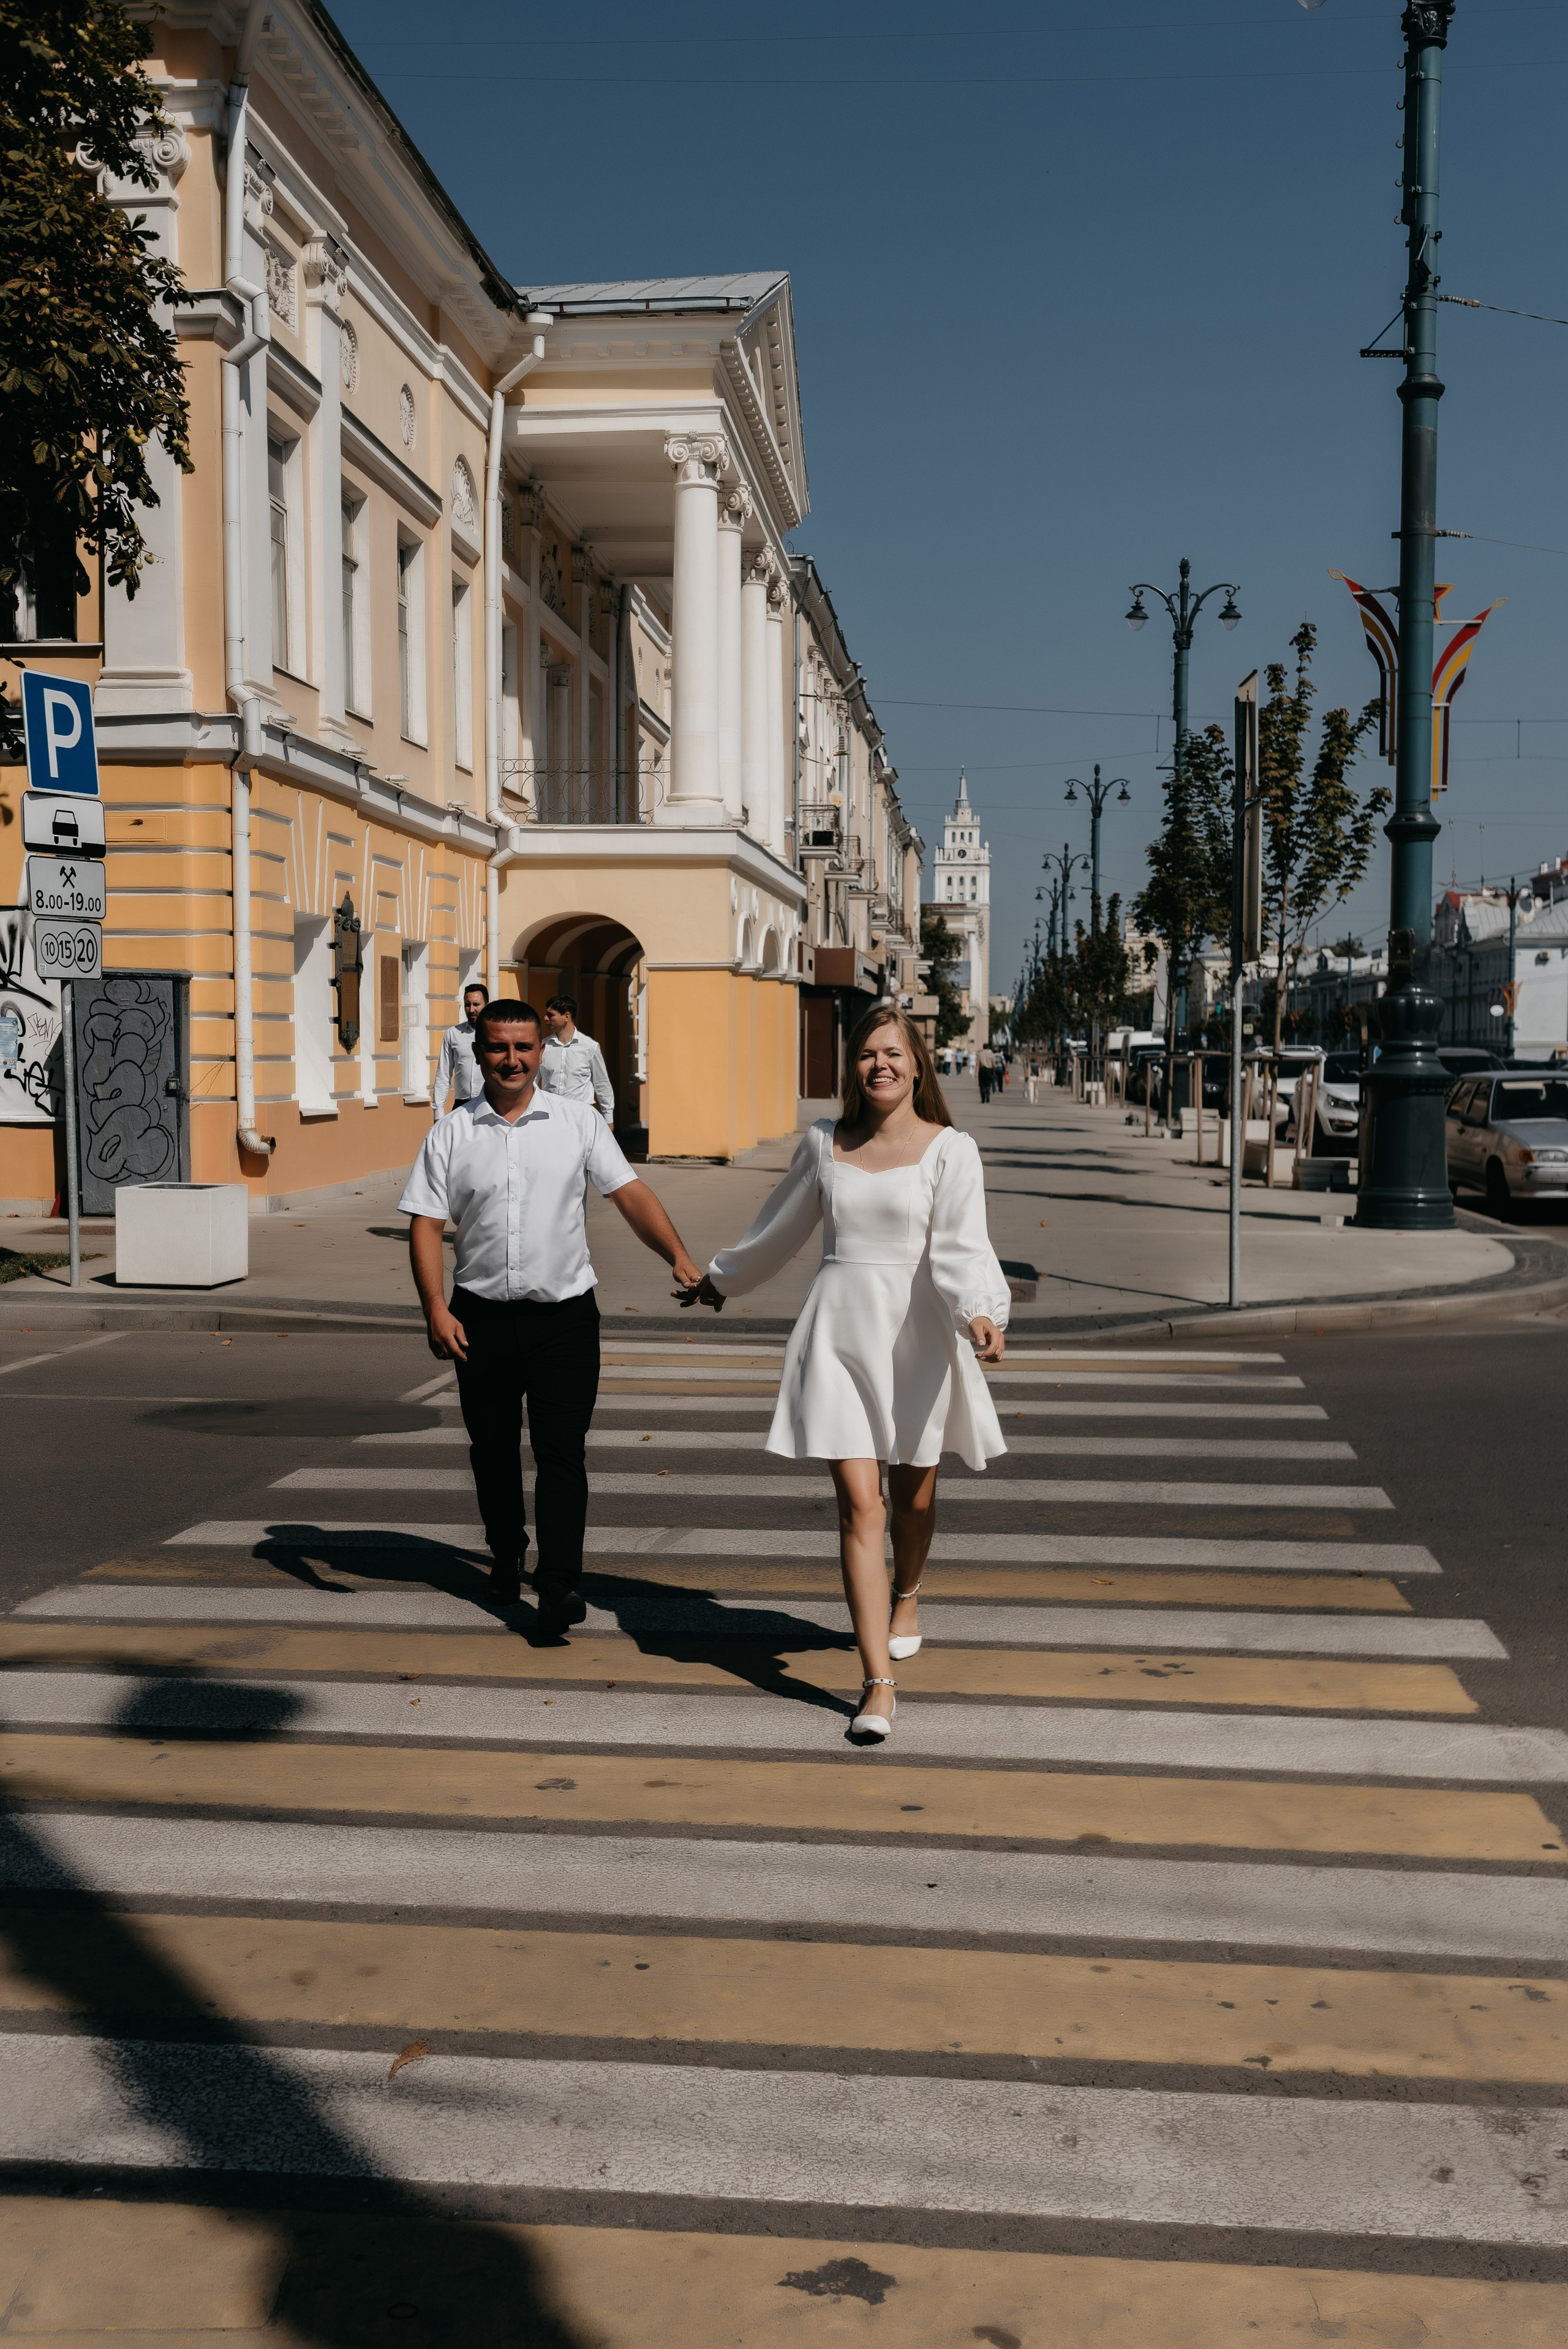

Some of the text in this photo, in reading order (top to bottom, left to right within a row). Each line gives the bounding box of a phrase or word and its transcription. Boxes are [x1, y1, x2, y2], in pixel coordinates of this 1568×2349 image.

[43, 687, 82, 779] P
[36, 889, 101, 912] 8.00-19.00
[45, 938, 95, 963] 10 15 20
